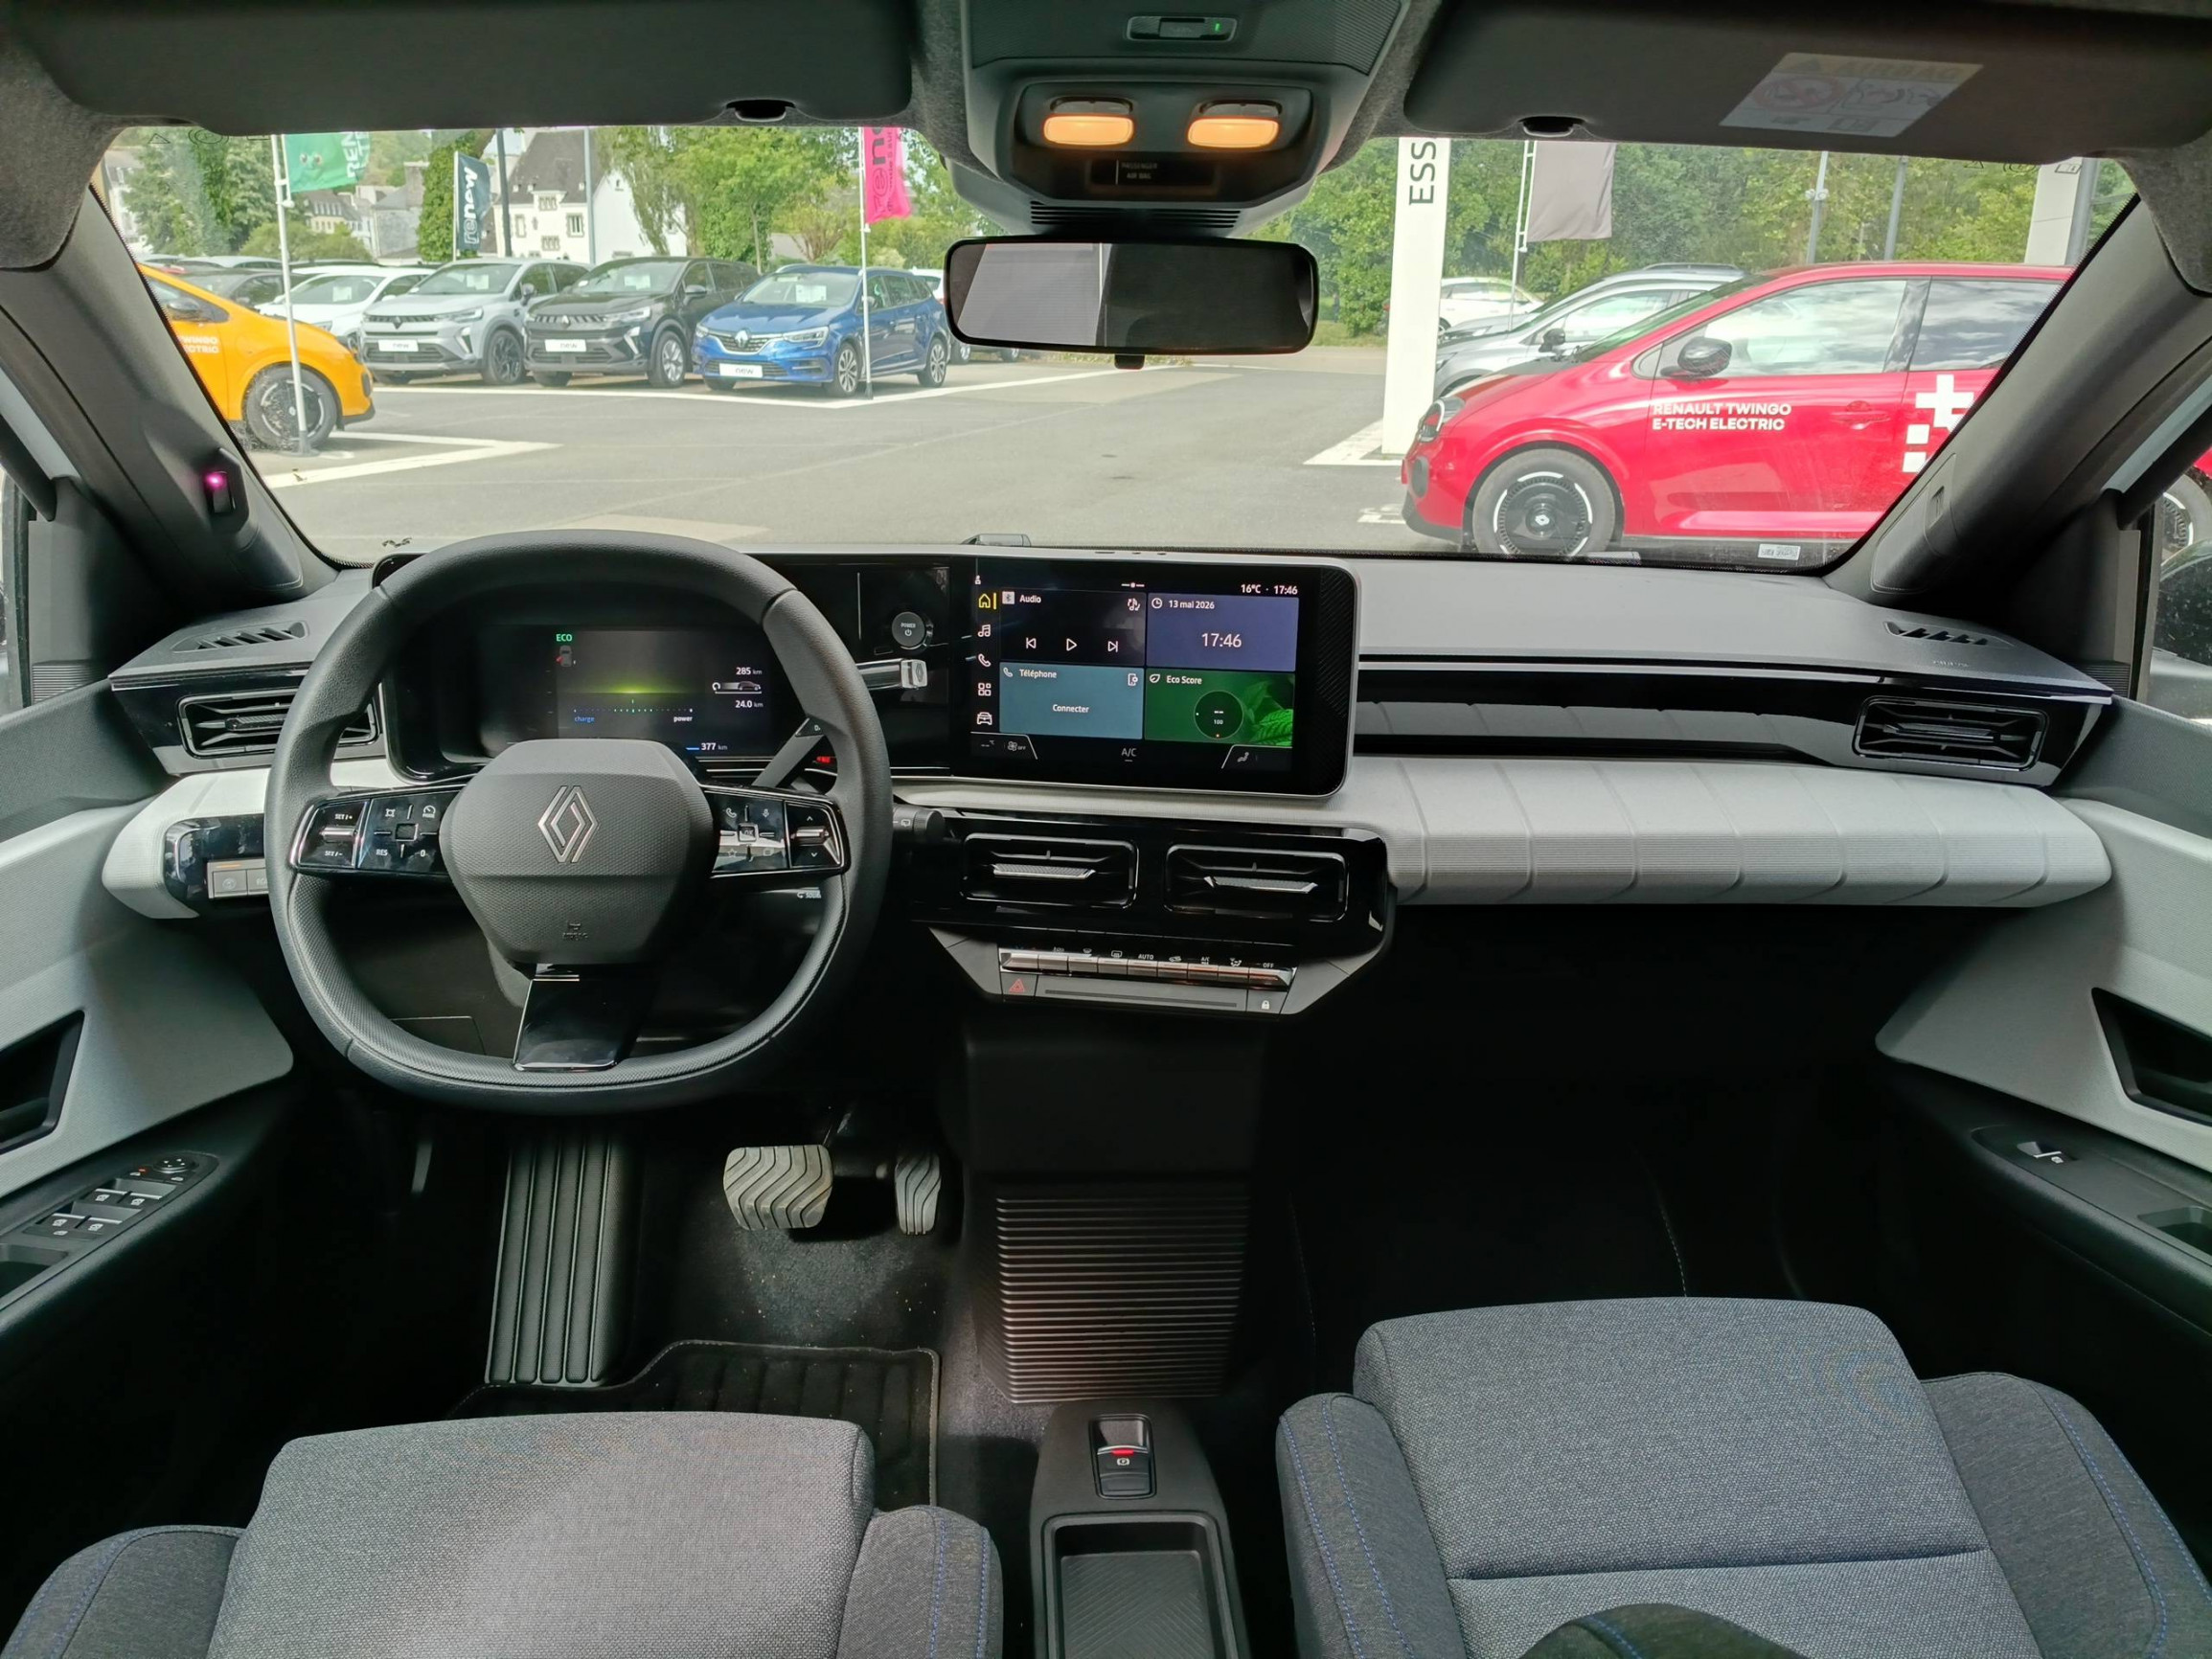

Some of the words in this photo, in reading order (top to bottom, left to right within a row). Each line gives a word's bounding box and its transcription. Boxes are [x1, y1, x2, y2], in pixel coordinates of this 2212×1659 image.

[1409, 141, 1437, 206] ESS
[464, 167, 480, 244] renew
[1653, 402, 1724, 415] RENAULT
[1725, 403, 1792, 416] TWINGO
[1652, 418, 1707, 430] E-TECH
[1709, 418, 1786, 431] ELECTRIC
[1273, 585, 1298, 596] 17:46
[1019, 593, 1042, 604] Audio
[1169, 599, 1178, 609] 13
[1179, 600, 1195, 609] mai
[1195, 600, 1216, 610] 2026
[556, 633, 573, 642] ECO
[1200, 632, 1243, 648] 17:46
[736, 667, 752, 675] 285
[1019, 668, 1058, 680] Téléphone
[1166, 674, 1180, 685] Eco
[1181, 676, 1202, 686] Score
[735, 699, 753, 709] 24.0
[1052, 703, 1090, 715] Connecter
[700, 742, 717, 751] 377
[1121, 747, 1137, 758] A/C
